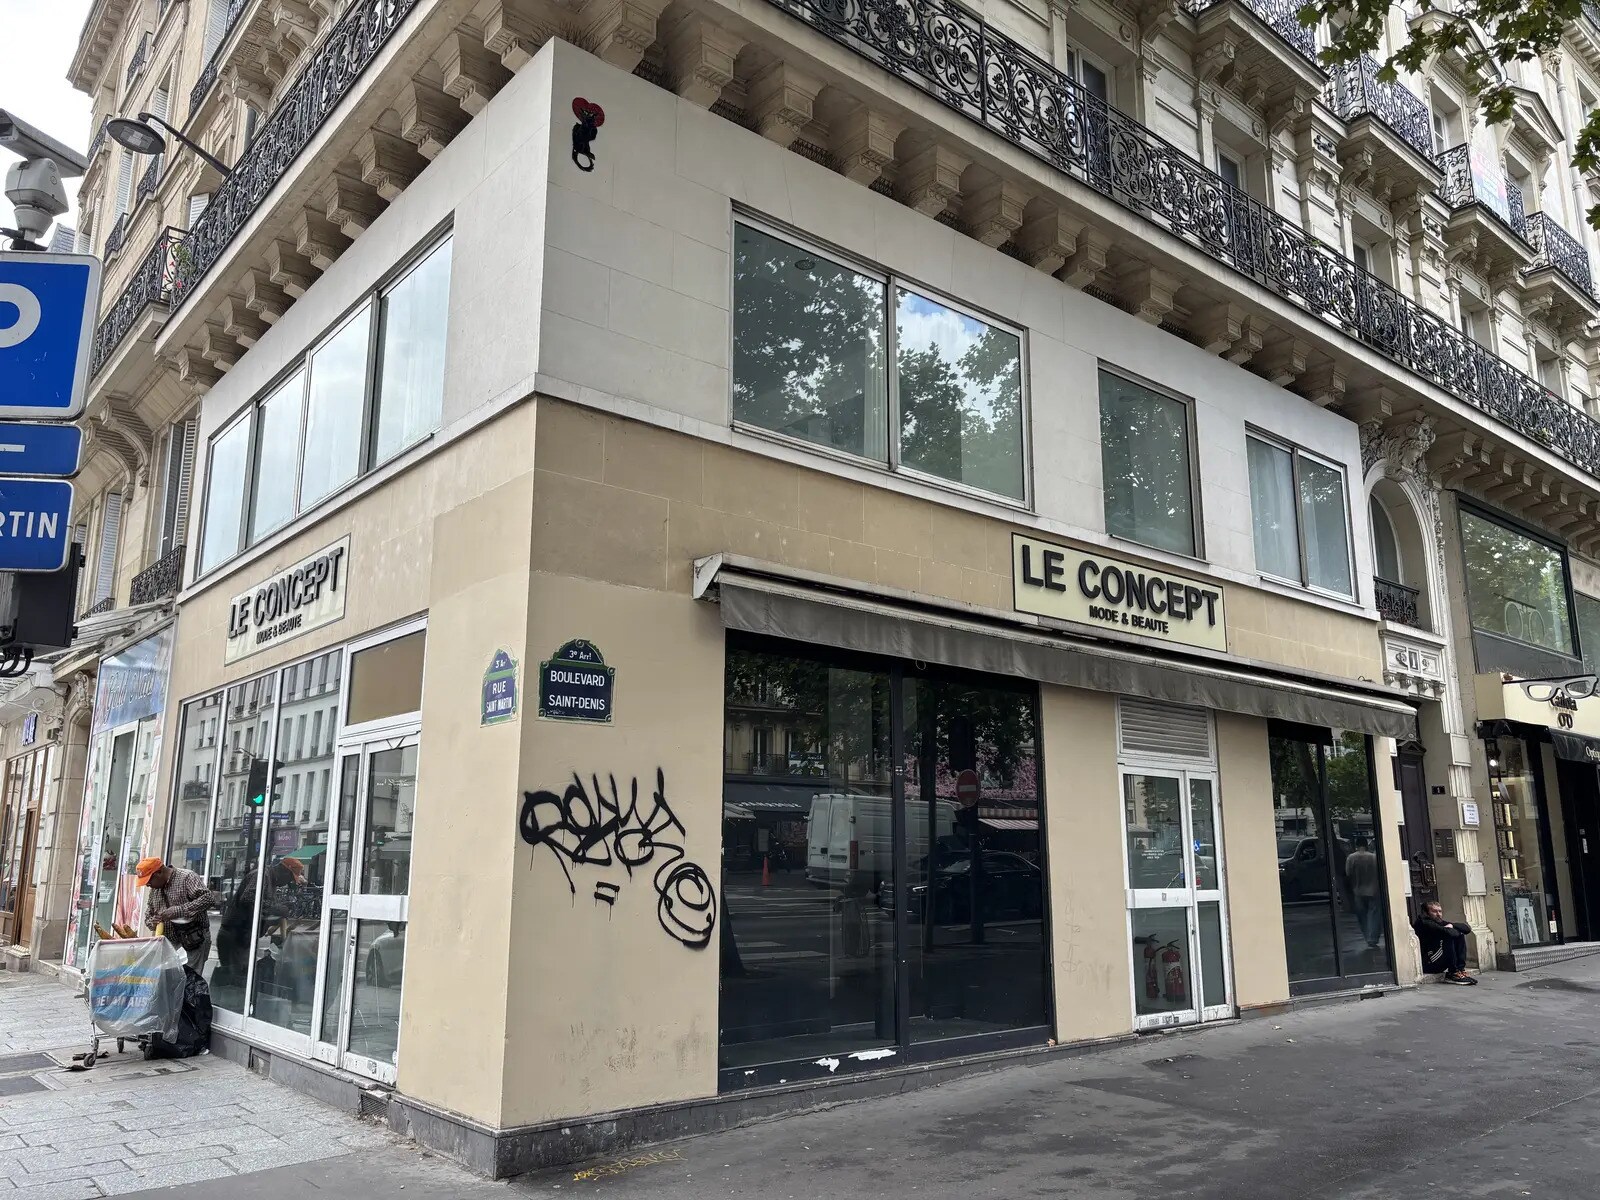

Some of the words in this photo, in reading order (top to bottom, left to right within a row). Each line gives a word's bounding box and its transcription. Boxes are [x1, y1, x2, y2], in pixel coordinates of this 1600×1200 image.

[228, 596, 250, 639] LE
[253, 547, 344, 626] CONCEPT
[1022, 544, 1066, 592] LE
[1078, 560, 1219, 626] CONCEPT
[1089, 605, 1119, 623] MODE
[1121, 612, 1129, 626] &
[1131, 614, 1169, 634] BEAUTE
[550, 670, 605, 687] BOULEVARD
[492, 681, 507, 695] RUE
[486, 700, 497, 713] SAINT
[548, 694, 606, 711] SAINT-DENIS
